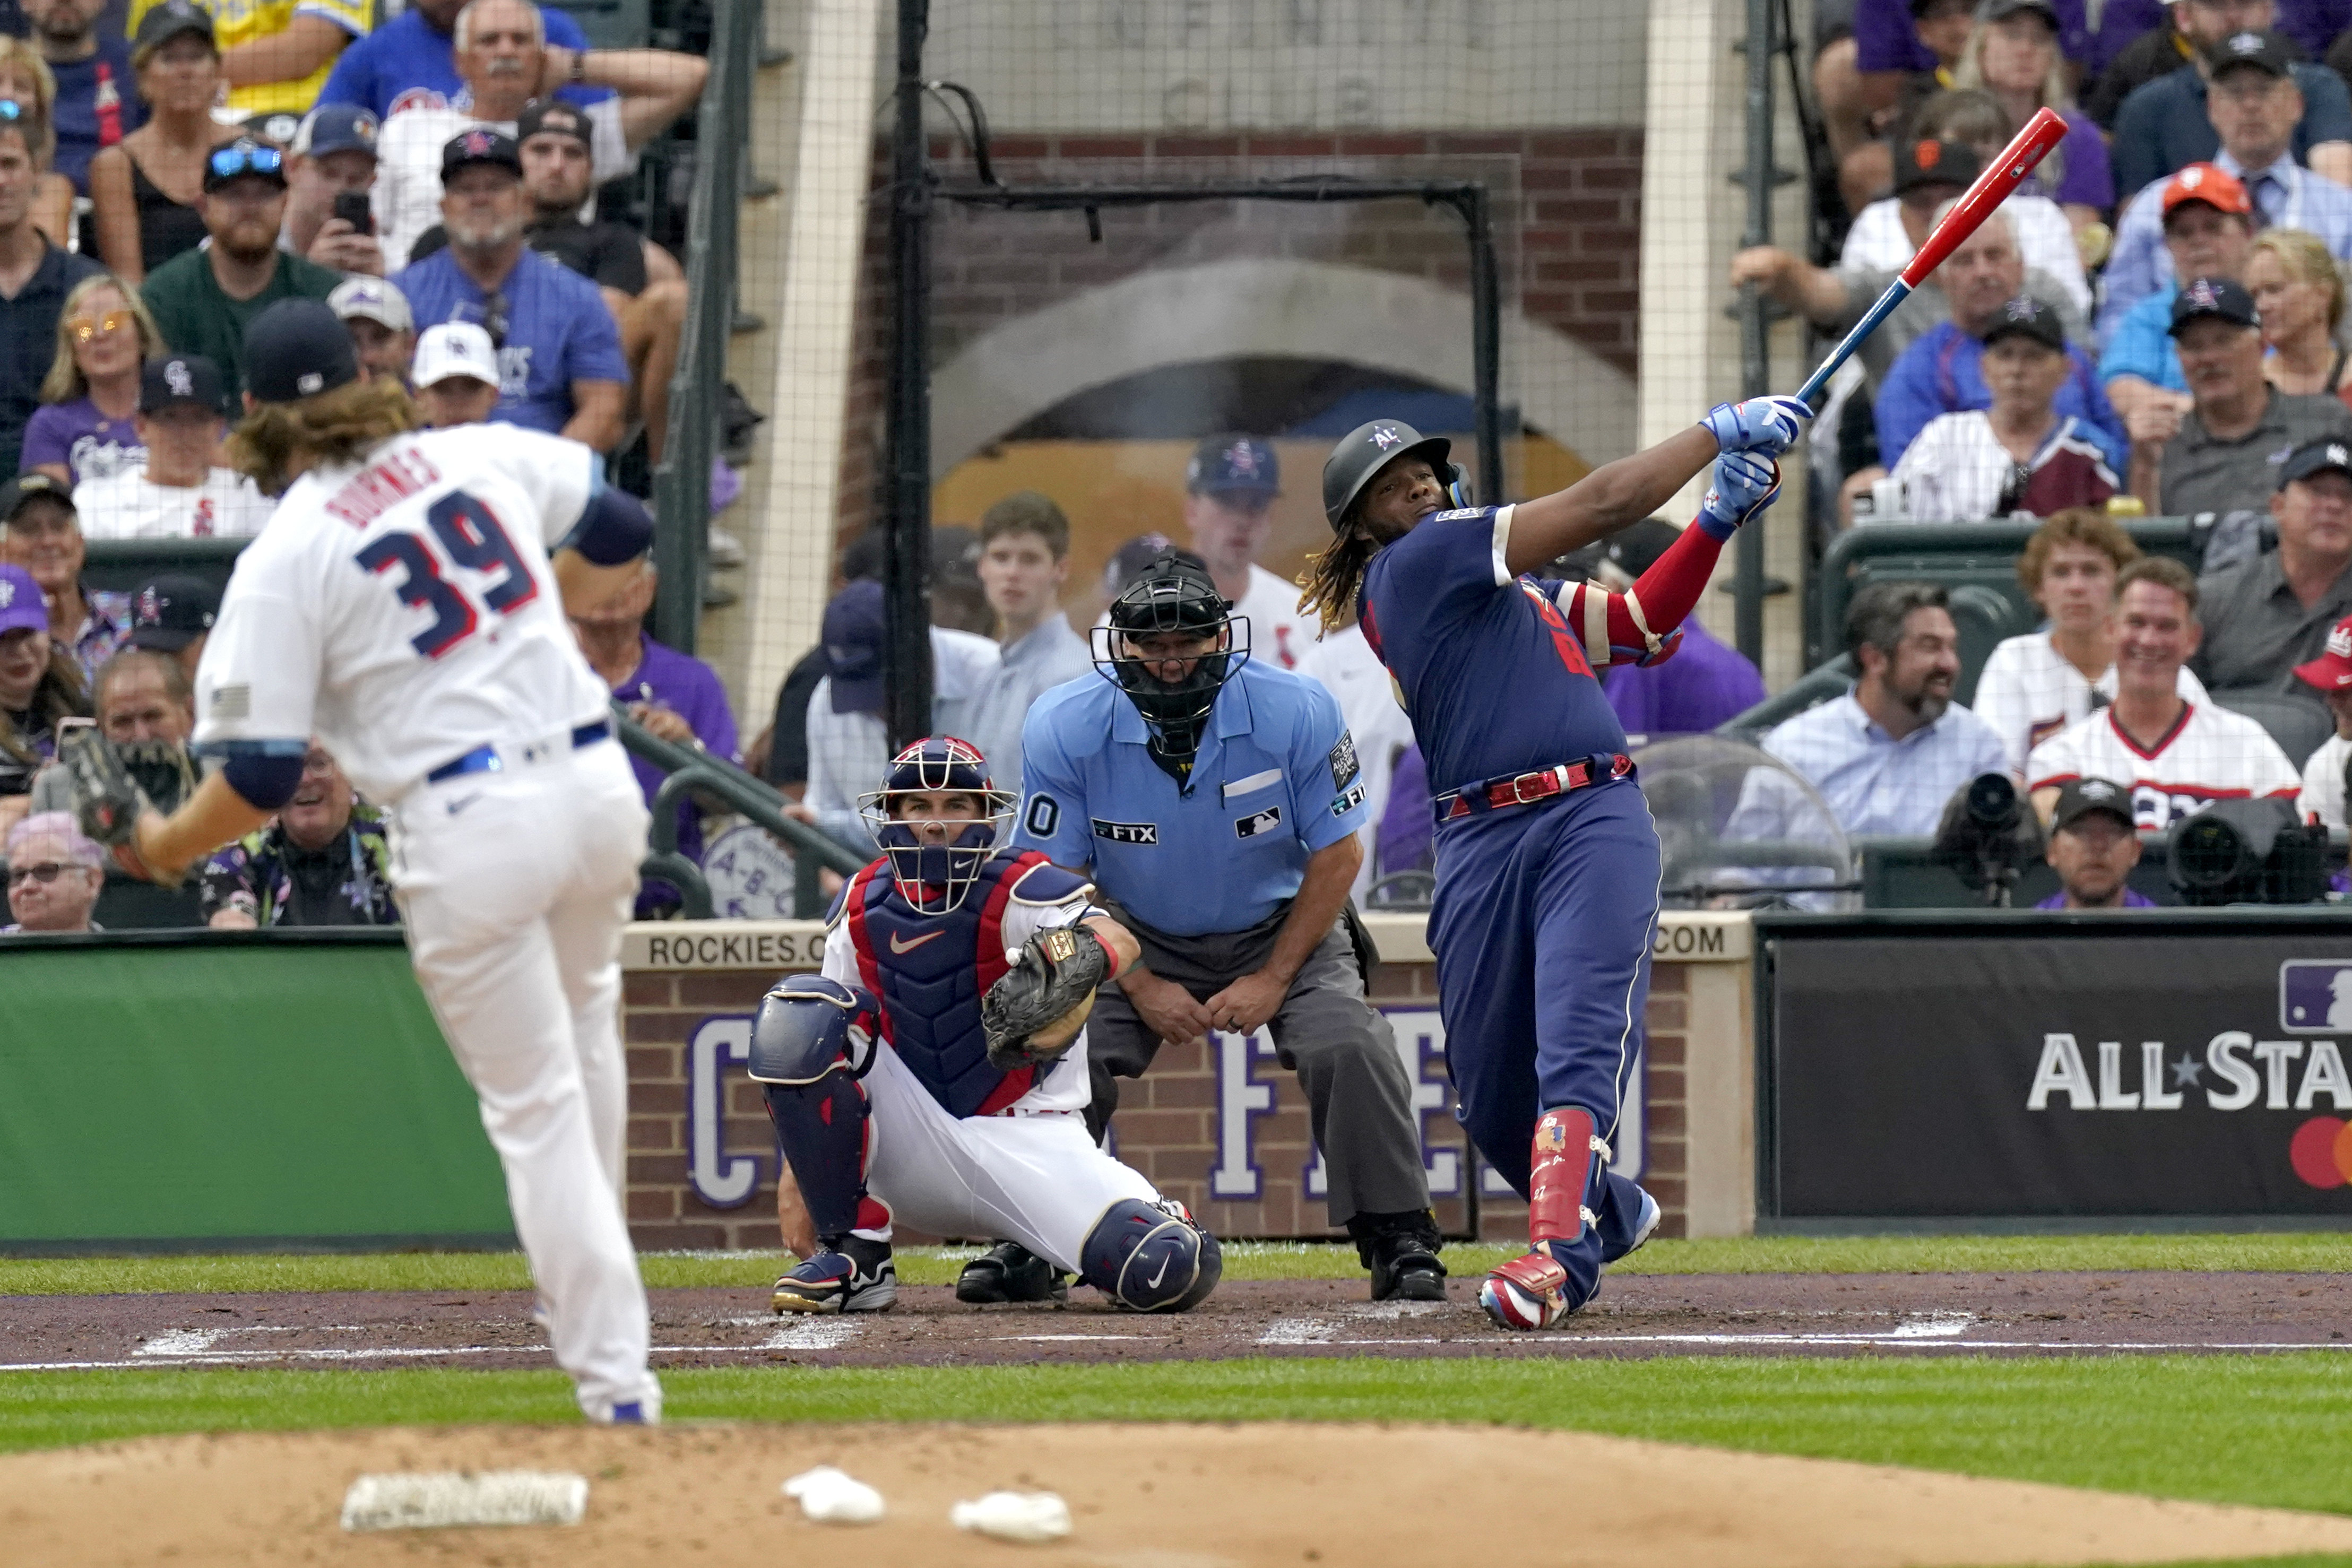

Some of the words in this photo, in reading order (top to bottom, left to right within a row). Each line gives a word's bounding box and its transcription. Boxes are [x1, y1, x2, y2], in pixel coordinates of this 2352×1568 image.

[1374, 429, 1398, 447] AL
[354, 489, 539, 661] 39
[1339, 755, 1354, 775] GAME
[1112, 825, 1156, 843] FTX
[2027, 1033, 2183, 1111] ALL
[1553, 1155, 1566, 1166] Jr.
[1534, 1185, 1546, 1200] 27
